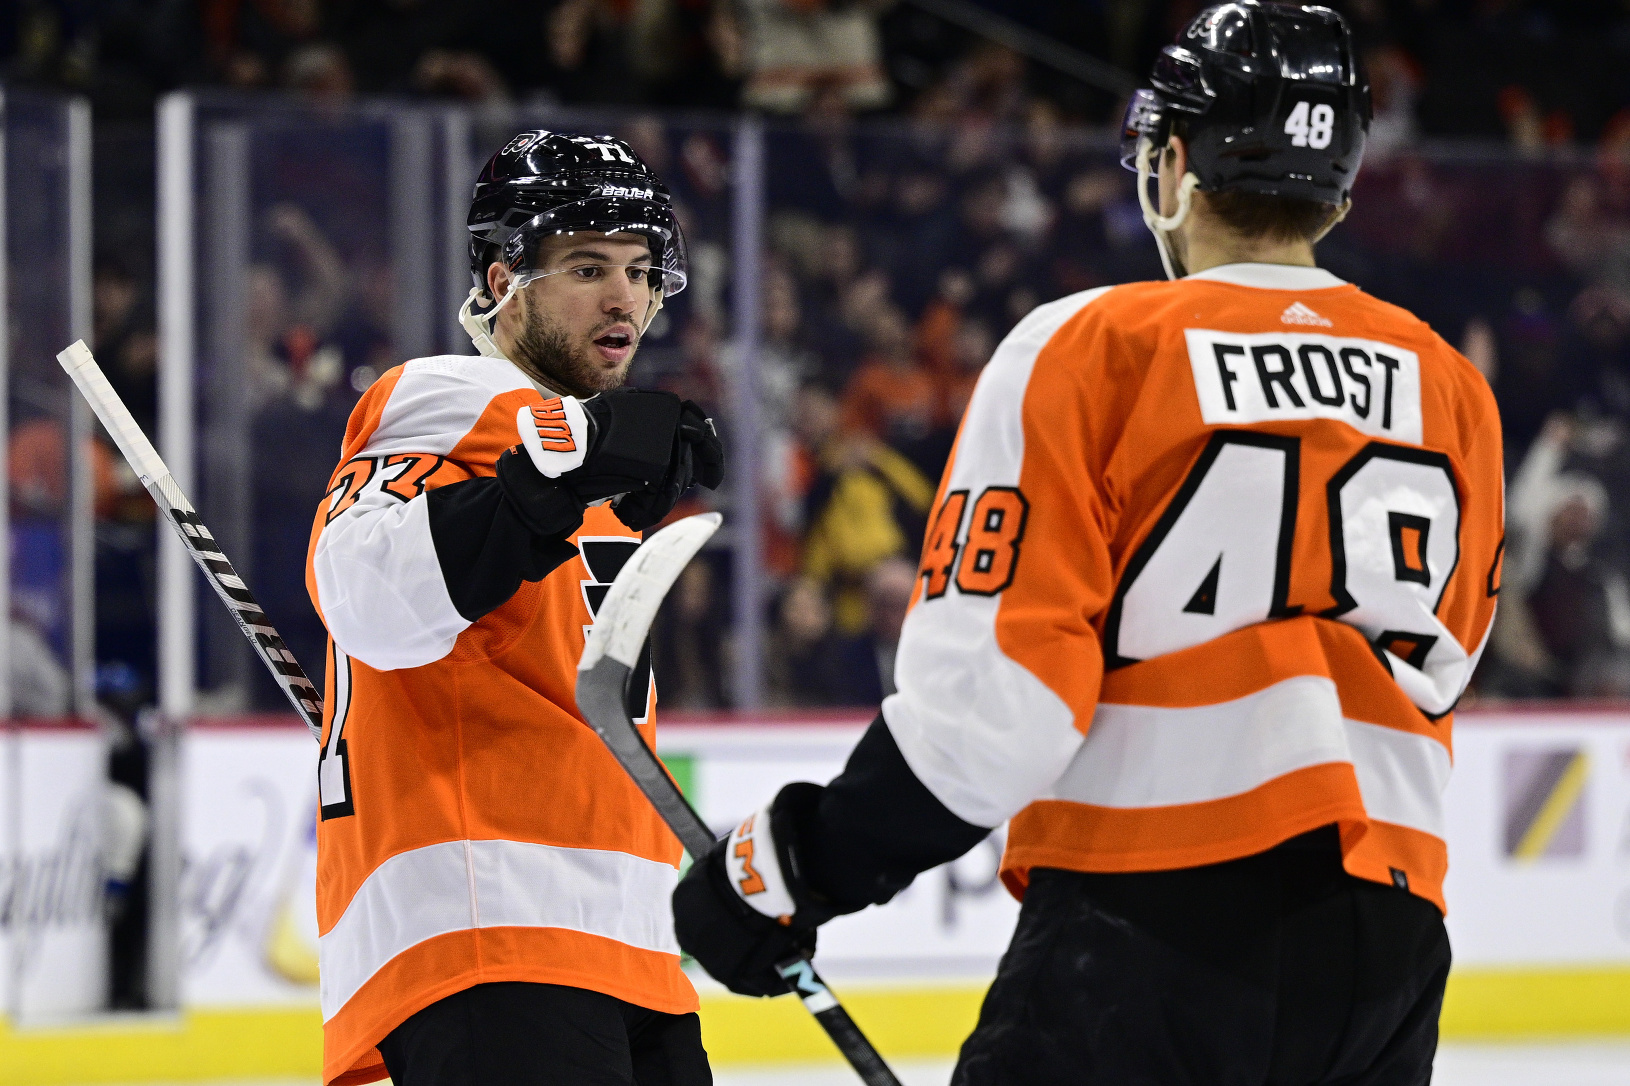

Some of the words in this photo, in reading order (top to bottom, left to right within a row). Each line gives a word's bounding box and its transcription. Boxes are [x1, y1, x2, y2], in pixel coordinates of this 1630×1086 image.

[1284, 101, 1335, 150] 48
[529, 396, 577, 453] WA
[1212, 343, 1400, 431] FROST
[920, 485, 1031, 603] 48
[1103, 429, 1469, 722] 48
